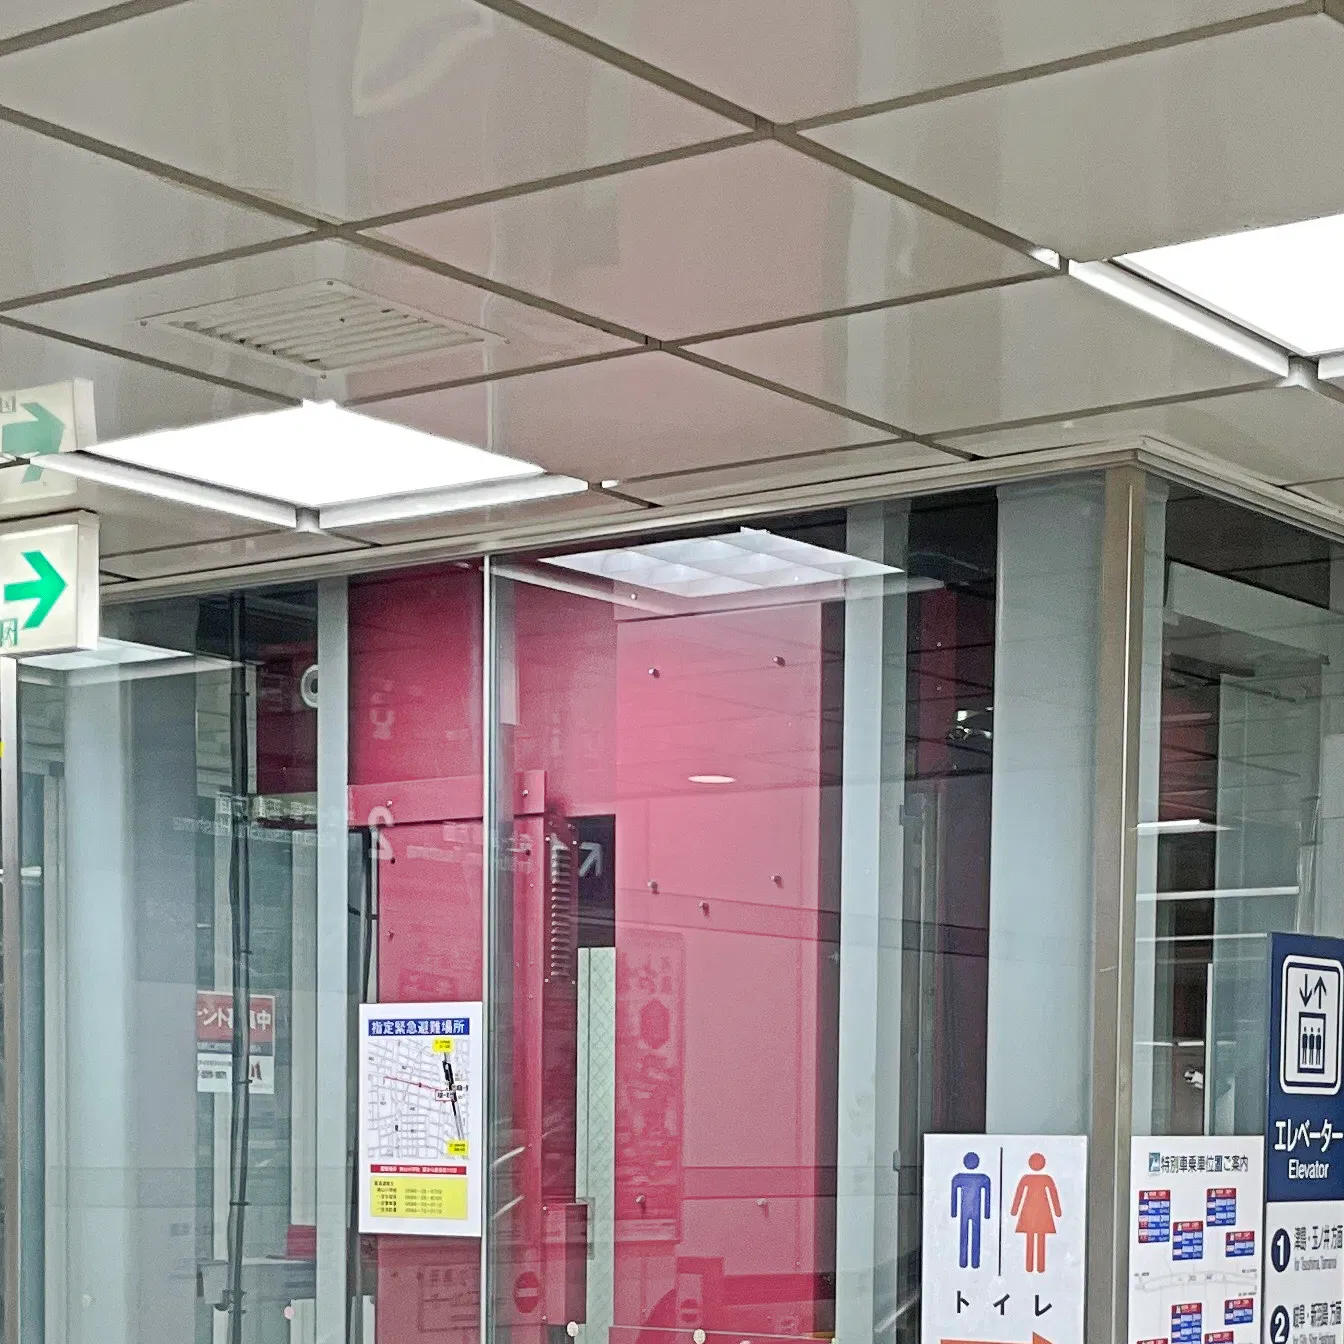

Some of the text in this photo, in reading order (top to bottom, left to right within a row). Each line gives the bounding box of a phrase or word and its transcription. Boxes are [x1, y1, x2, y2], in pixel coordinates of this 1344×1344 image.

[370, 1019, 465, 1035] 指定緊急避難場所
[1274, 1118, 1344, 1152] エレベーター
[1288, 1158, 1330, 1180] Elevator
[956, 1290, 1053, 1317] トイレ
